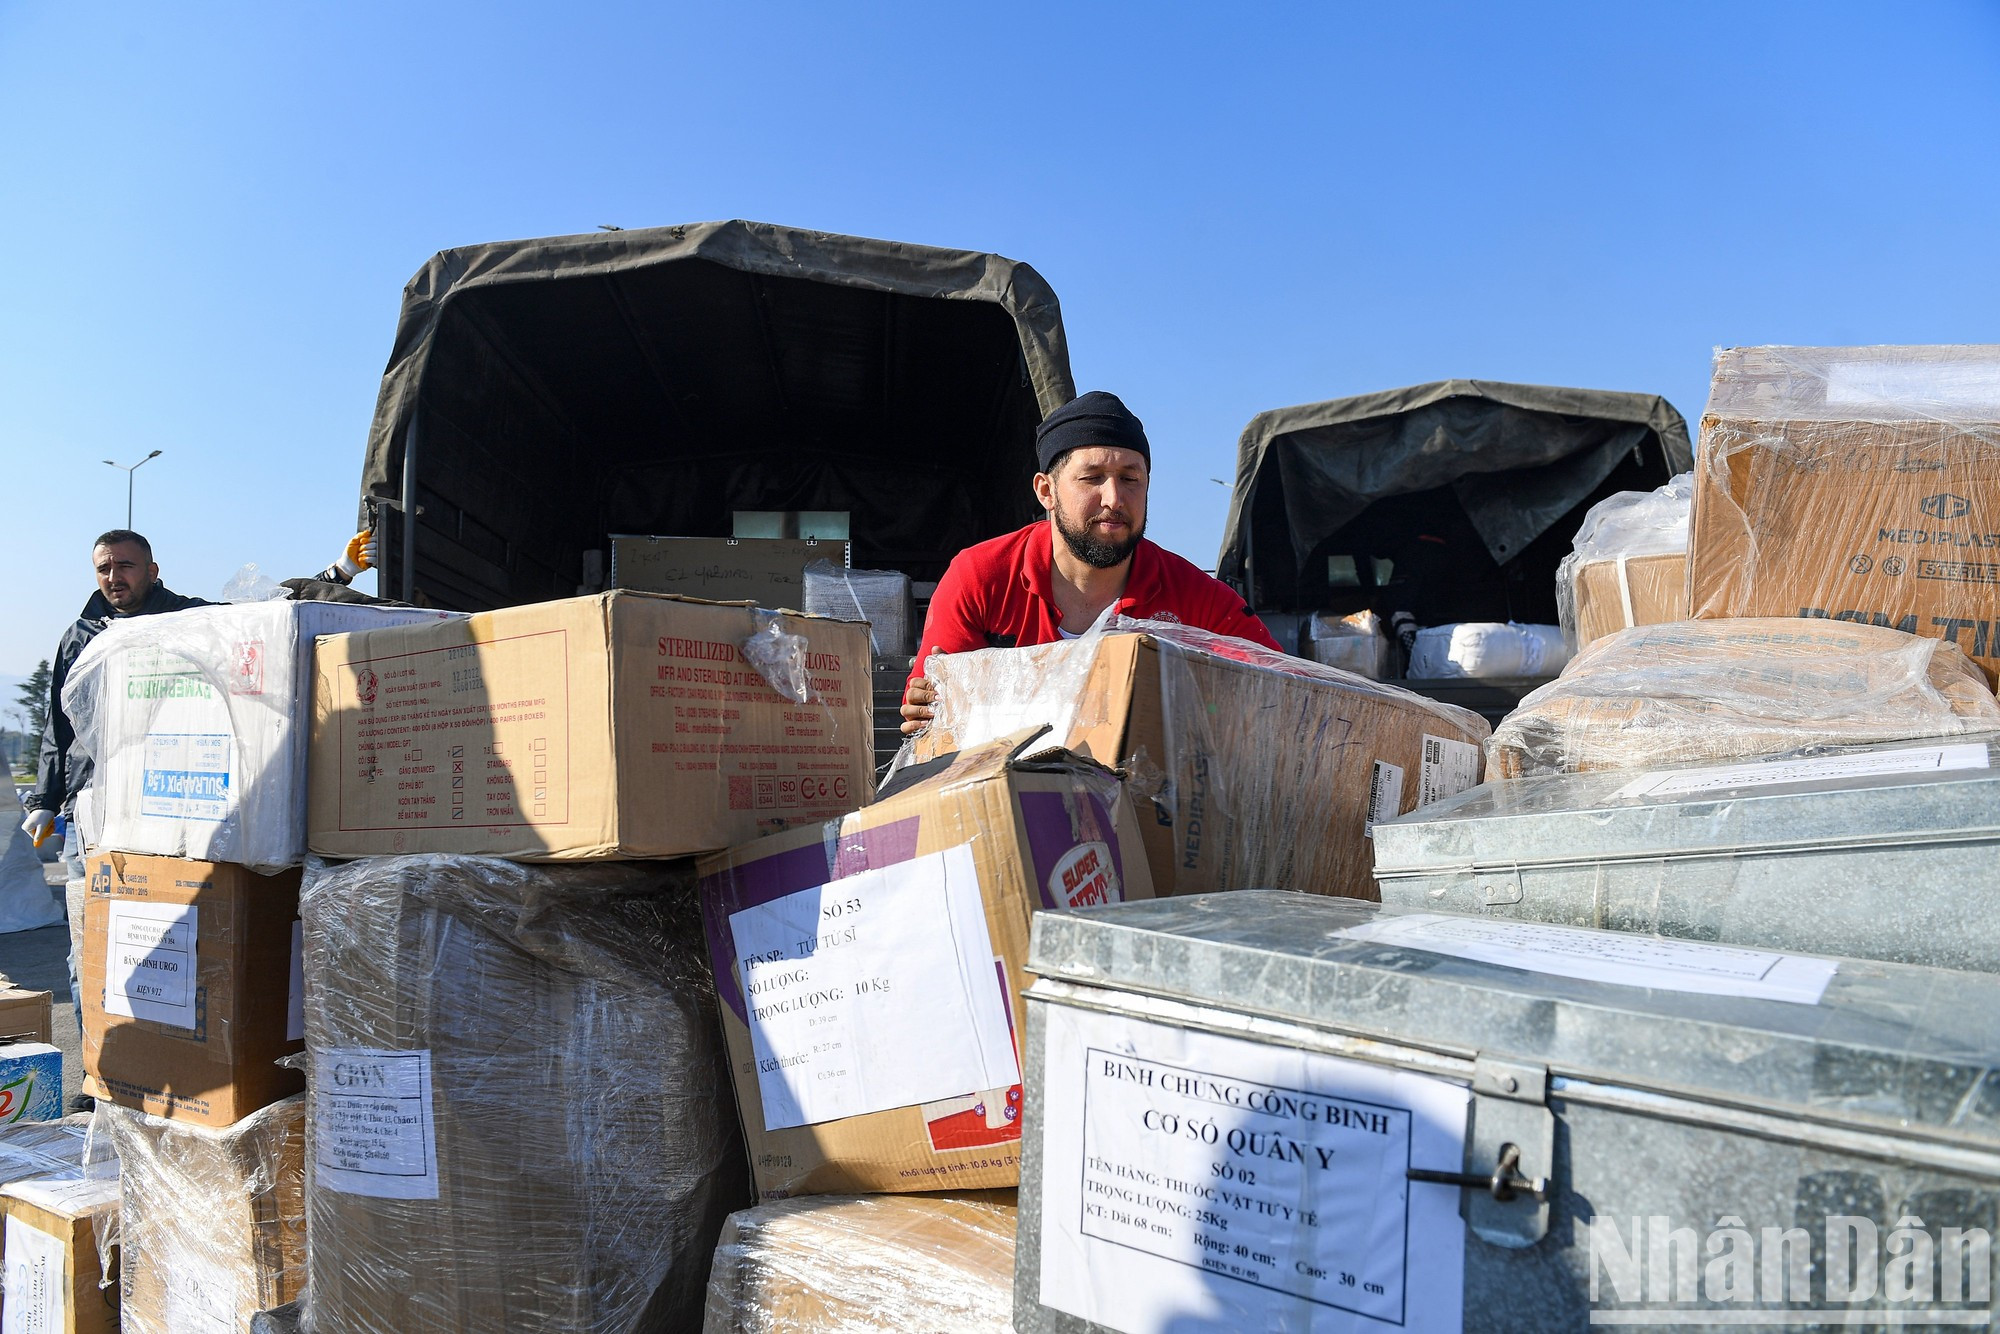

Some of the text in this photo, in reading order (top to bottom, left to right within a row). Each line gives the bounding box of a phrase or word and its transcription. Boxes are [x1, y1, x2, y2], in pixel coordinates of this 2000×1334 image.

[1925, 564, 1998, 581] STERILE
[658, 637, 734, 662] STERILIZED
[658, 666, 742, 685] MFR AND STERILIZED AT
[815, 678, 841, 692] COMPANY
[518, 699, 533, 707] FROM
[500, 714, 517, 722] PAIRS
[758, 783, 773, 793] TCVN
[779, 781, 796, 793] ISO
[1062, 849, 1100, 894] SUPER
[93, 875, 110, 893] AP
[822, 899, 862, 921] SỐ 53
[797, 936, 819, 955] TÚI
[159, 961, 178, 973] URGO
[743, 949, 784, 972] TÊN SP:
[763, 969, 809, 990] LƯỢNG:
[855, 977, 890, 995] 10 Kg
[751, 988, 844, 1023] TRỌNG LƯỢNG:
[818, 1015, 828, 1023] 39
[822, 1043, 831, 1052] 27
[832, 1042, 842, 1050] cm
[760, 1057, 780, 1073] Kích
[827, 1070, 836, 1078] 36
[836, 1068, 847, 1077] cm
[1104, 1060, 1153, 1087] BINH
[1248, 1090, 1317, 1121] CÔNG
[1325, 1104, 1389, 1135] BINH
[1143, 1109, 1180, 1135] CƠ
[1227, 1129, 1306, 1165] QUÂN
[1315, 1146, 1335, 1170] Y
[899, 1167, 920, 1178] Khối
[969, 1159, 988, 1170] 10,8
[989, 1157, 1002, 1168] kg
[1003, 1156, 1013, 1167] (3
[1211, 1161, 1256, 1186] SỐ 02
[1088, 1157, 1112, 1174] TÊN
[1117, 1165, 1160, 1187] HÀNG:
[1222, 1191, 1253, 1210] VẬT
[1256, 1201, 1280, 1217] TƯ
[1282, 1206, 1293, 1220] Y
[1086, 1179, 1228, 1231] TRỌNG LƯỢNG: 25Kg
[1086, 1203, 1385, 1295] KT: Dài 68 cm; Rộng: 40 cm; Cao: 30 cm
[1230, 1265, 1241, 1276] 02
